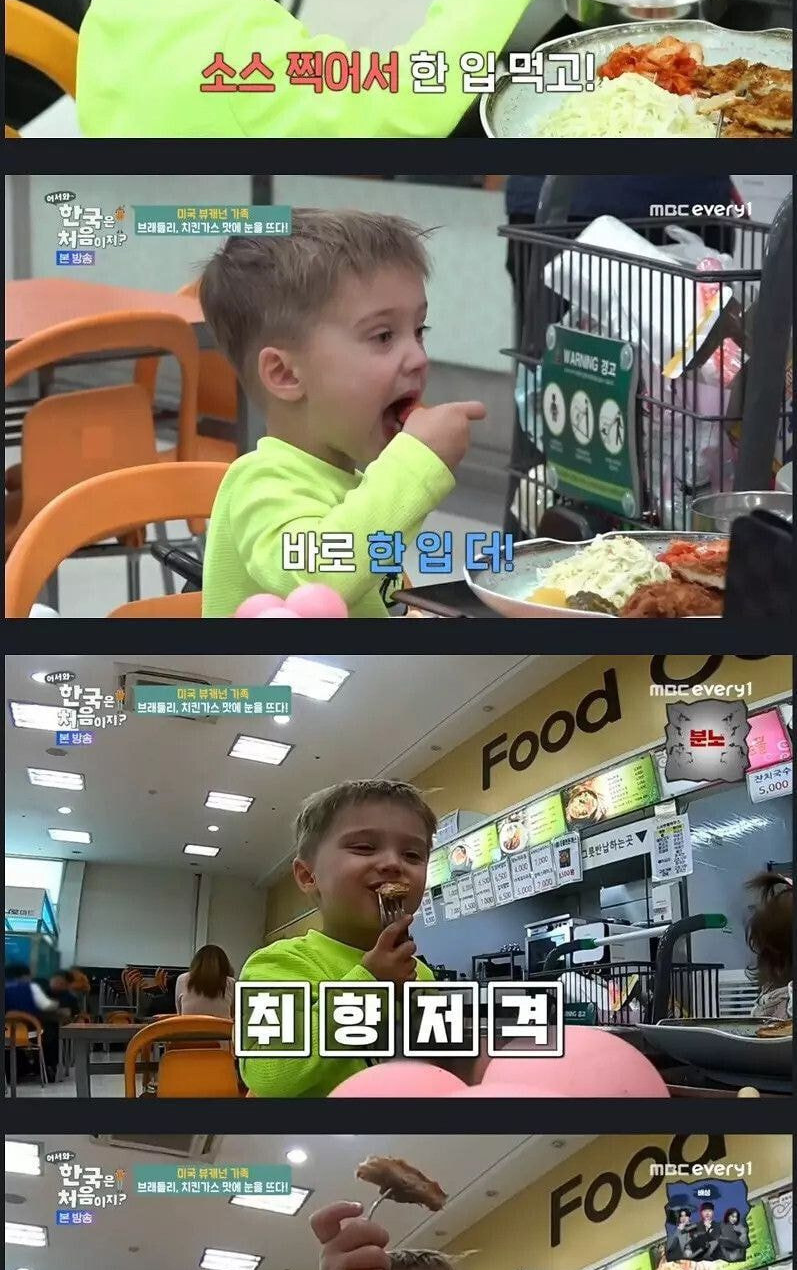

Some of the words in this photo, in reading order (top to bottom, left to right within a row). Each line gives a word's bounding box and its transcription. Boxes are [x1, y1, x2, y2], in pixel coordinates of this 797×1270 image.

[563, 349, 599, 370] WARNING
[482, 668, 622, 791] Food
[759, 780, 789, 795] 5,000
